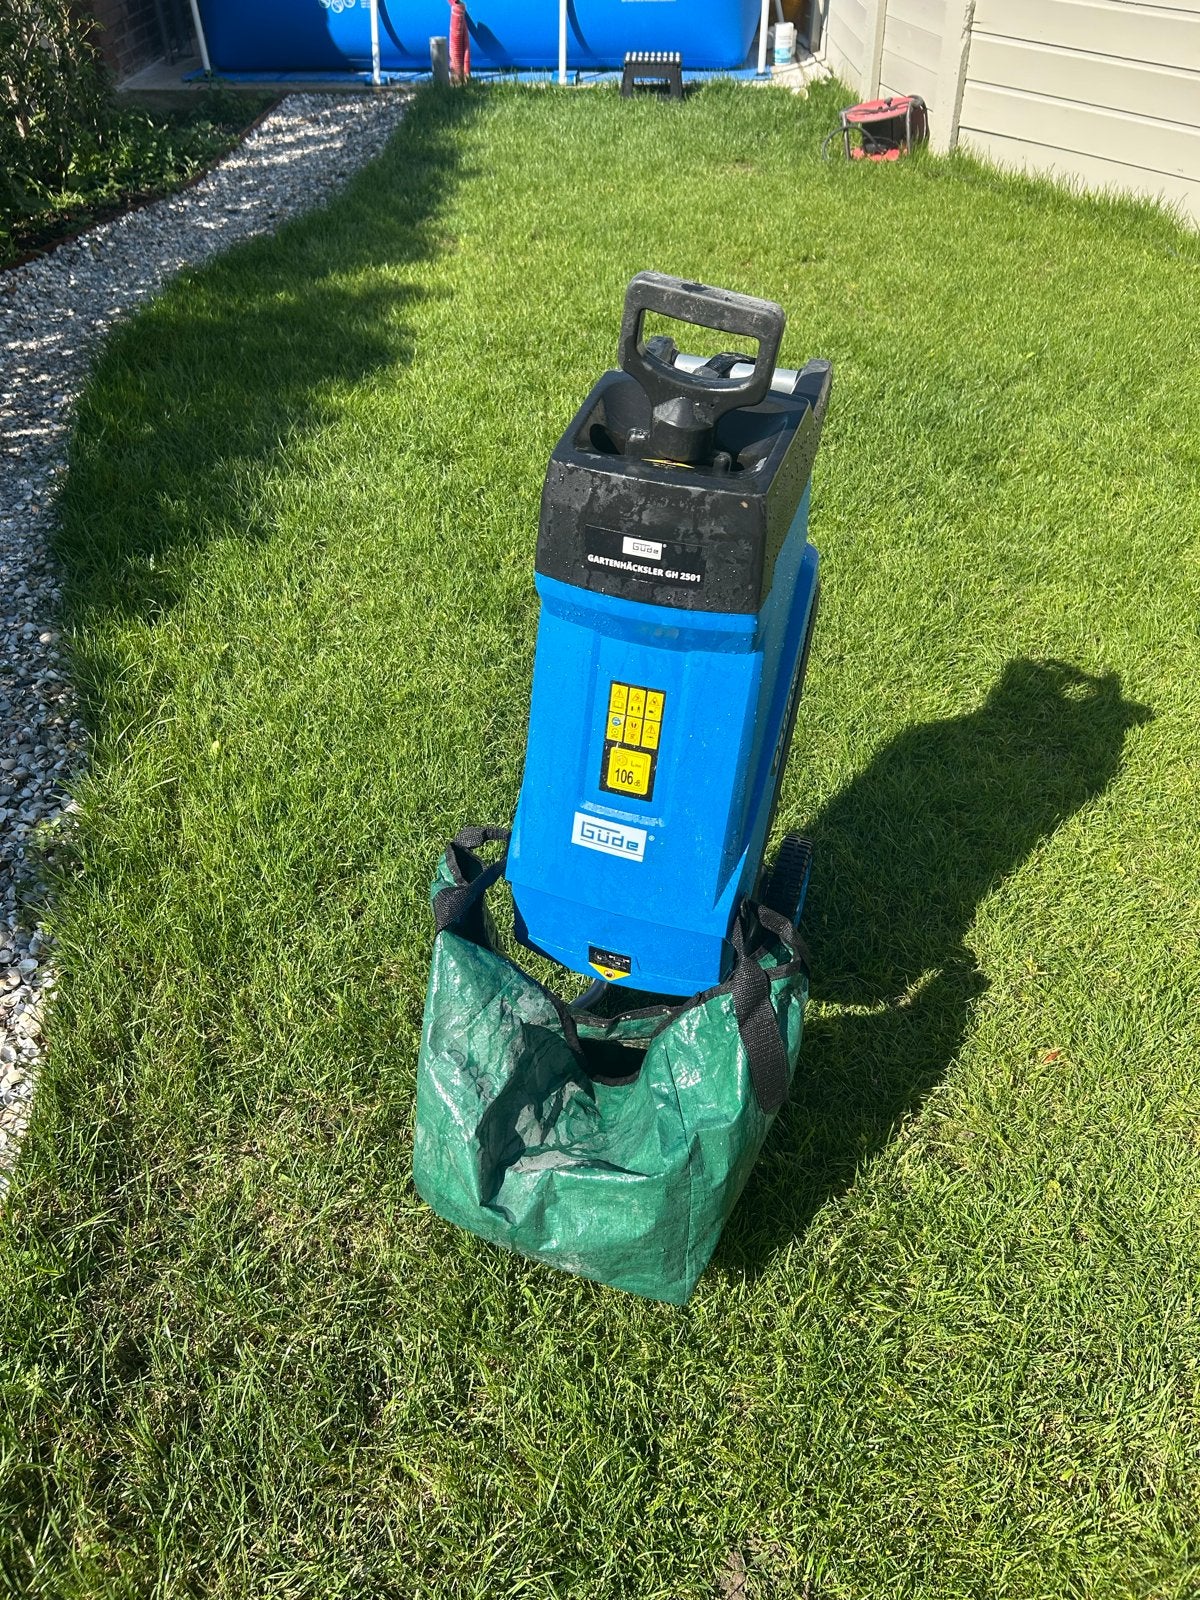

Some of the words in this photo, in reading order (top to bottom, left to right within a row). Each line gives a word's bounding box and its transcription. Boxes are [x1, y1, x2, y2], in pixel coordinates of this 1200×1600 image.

[587, 554, 664, 577] GARTENHÄCKSLER
[665, 569, 679, 579] GH
[680, 572, 701, 582] 2501
[615, 768, 634, 785] 106
[580, 820, 639, 852] Güde
